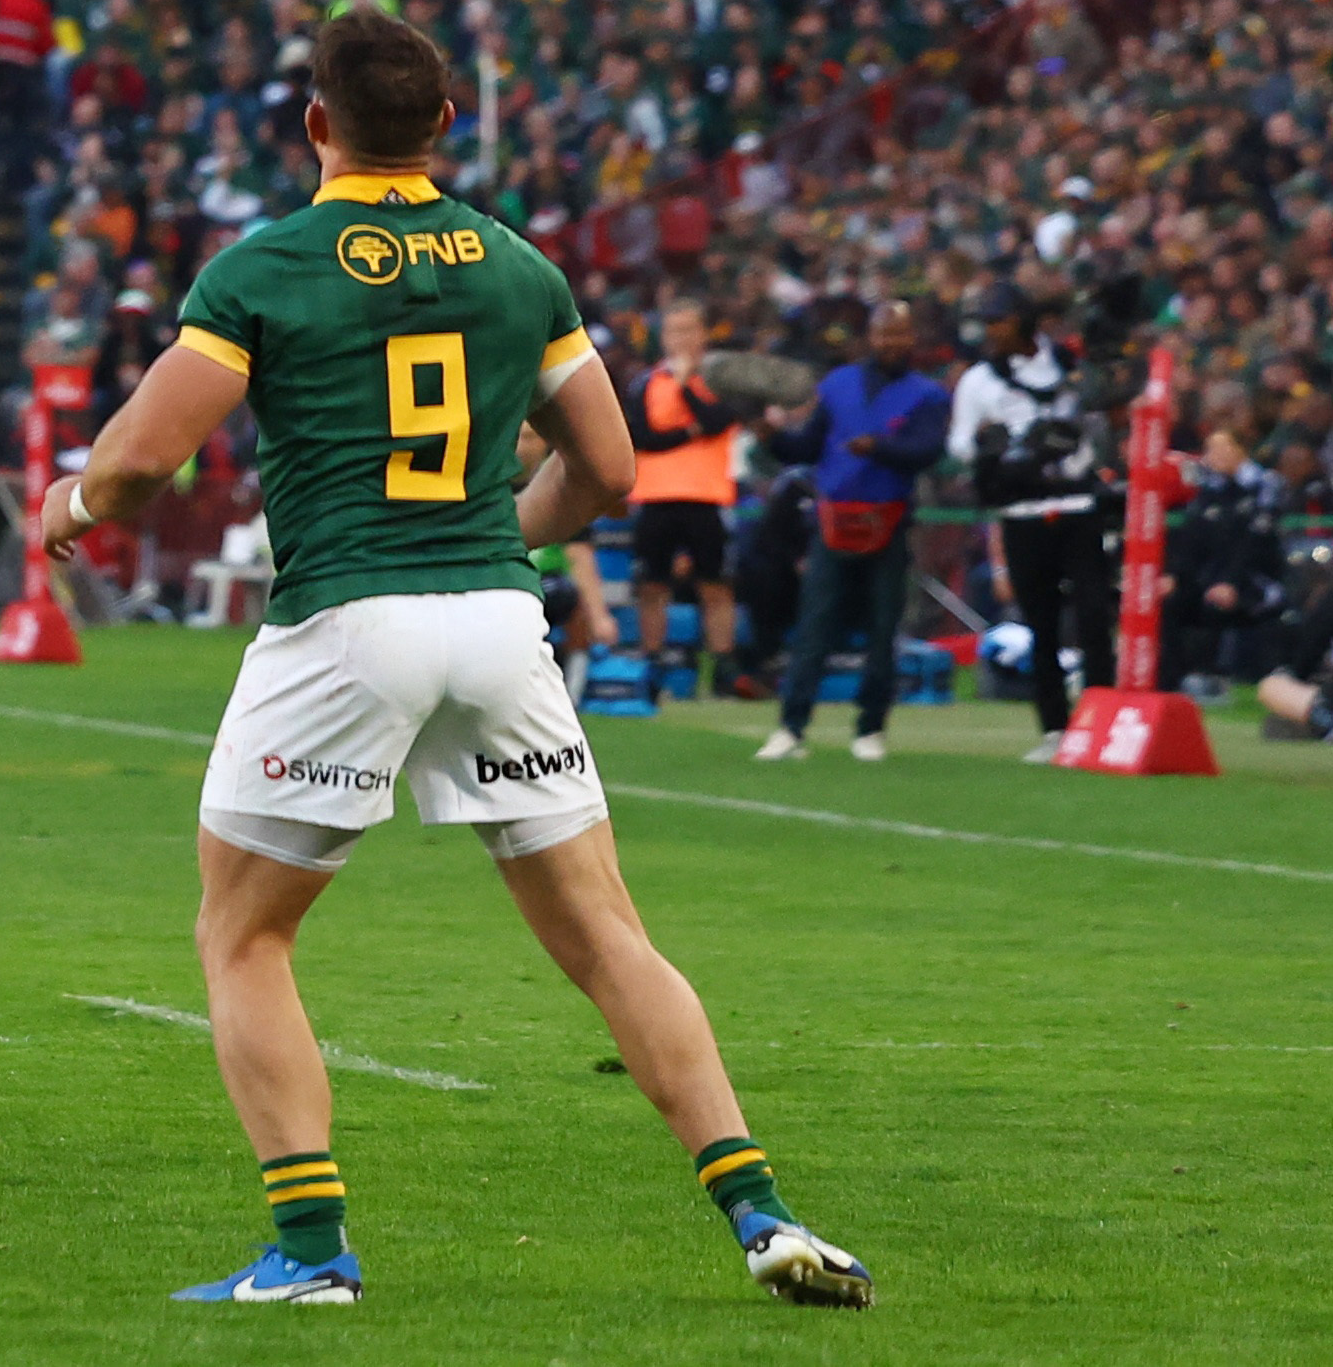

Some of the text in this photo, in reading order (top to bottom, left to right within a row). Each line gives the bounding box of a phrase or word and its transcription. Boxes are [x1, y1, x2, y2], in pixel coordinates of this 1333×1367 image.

[404, 229, 485, 266] FNB
[386, 332, 471, 502] 9
[288, 758, 393, 792] SWITCH
[475, 739, 586, 784] betway
